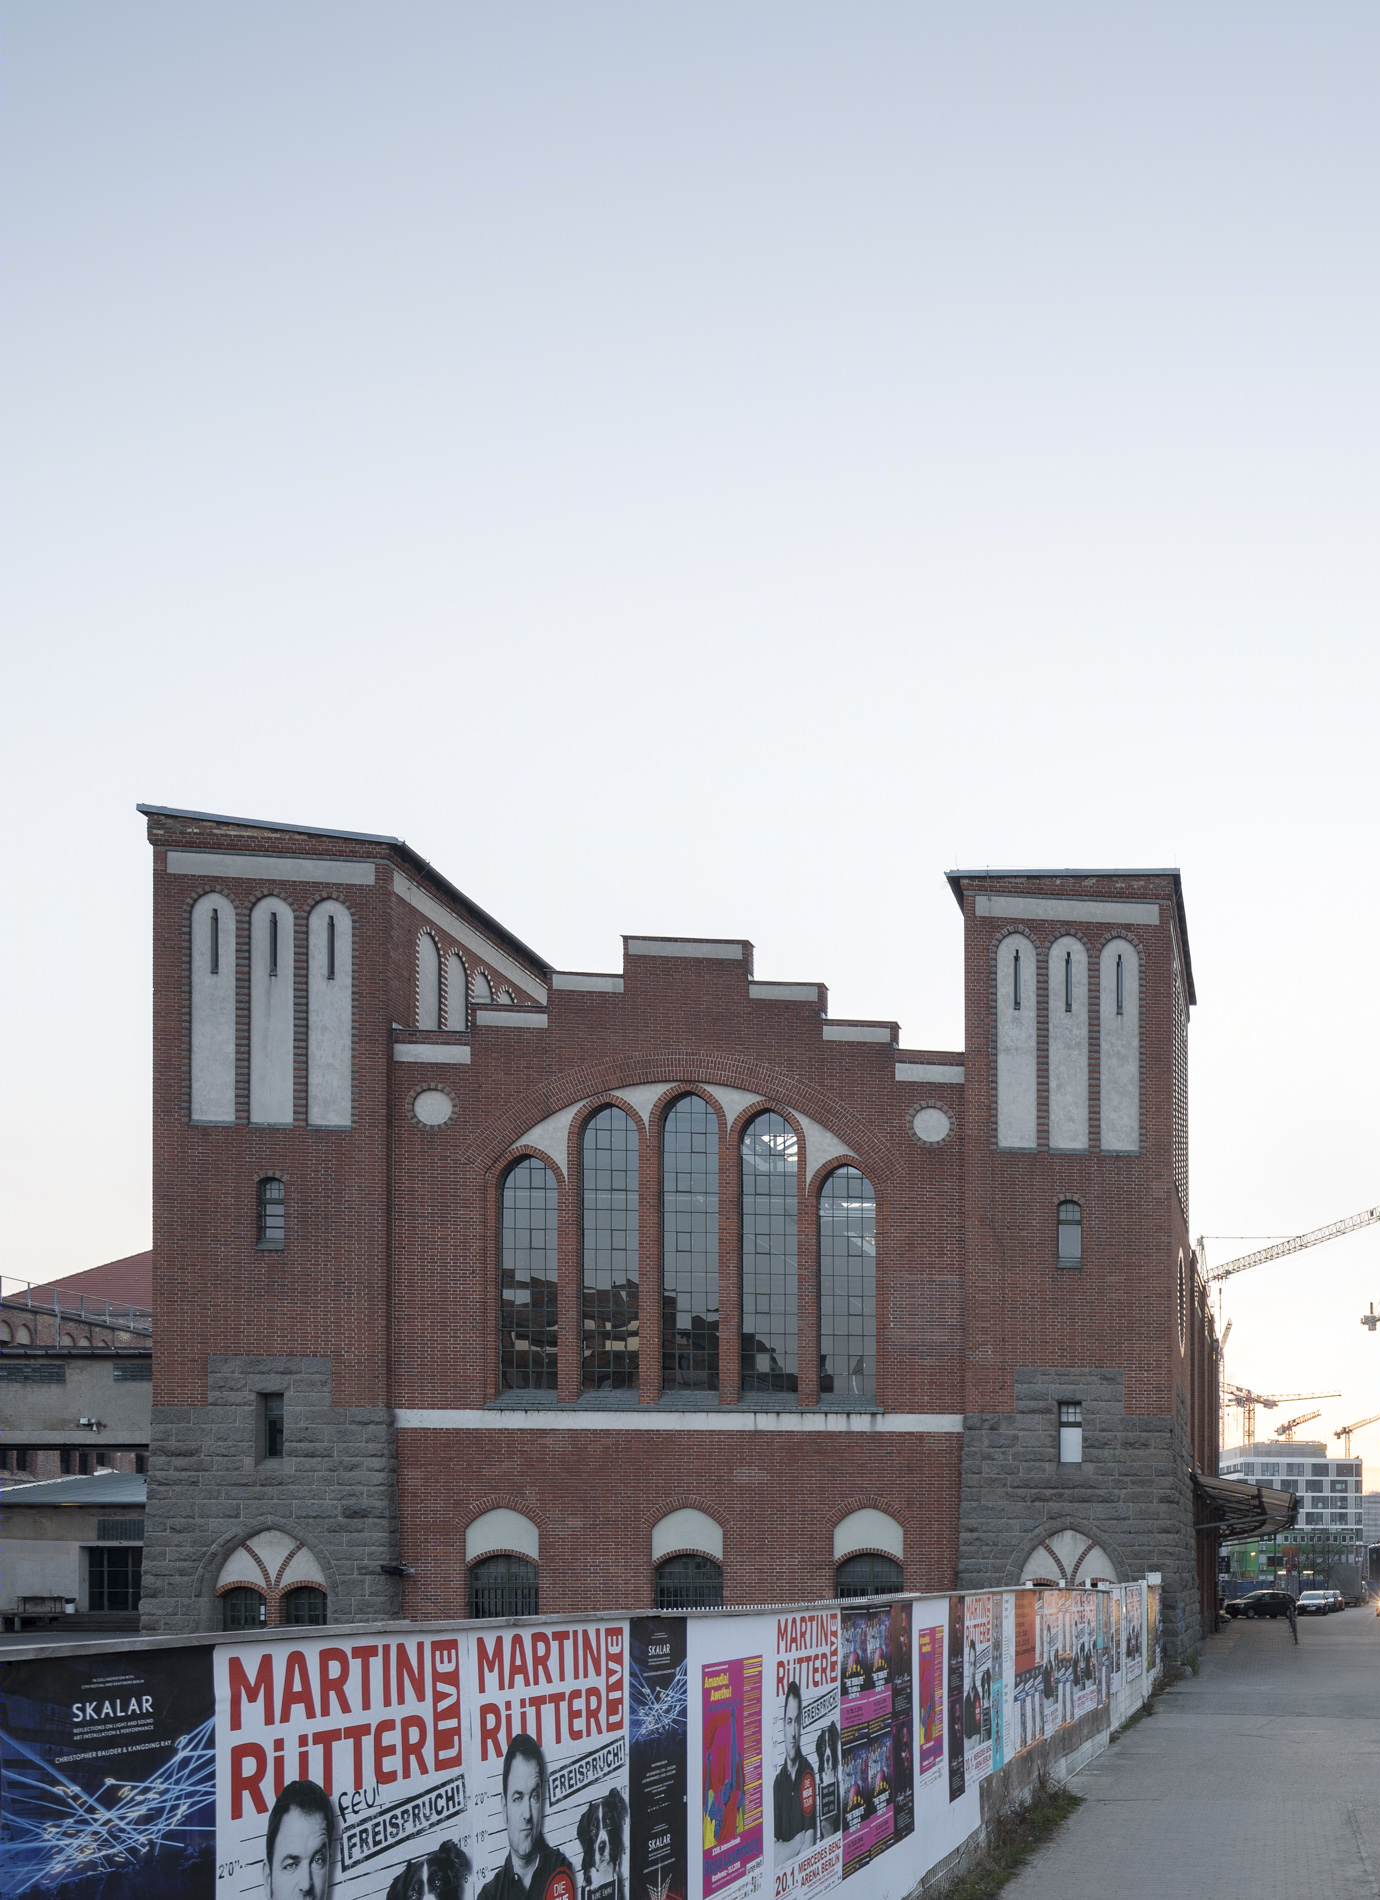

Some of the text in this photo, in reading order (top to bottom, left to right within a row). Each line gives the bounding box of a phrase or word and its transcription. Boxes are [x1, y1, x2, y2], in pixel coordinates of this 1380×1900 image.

[648, 1643, 671, 1656] SKALAR
[776, 1613, 829, 1655] MARTIN
[830, 1618, 838, 1678] LIVE
[476, 1628, 602, 1694] MARTIN
[607, 1634, 624, 1725] LIVE
[229, 1641, 426, 1732] MARTIN
[435, 1648, 460, 1762] LIVE
[72, 1695, 154, 1722] SKALAR
[73, 1724, 105, 1734] REFLECTIONS
[113, 1721, 127, 1729] LIGHT
[137, 1718, 154, 1726] SOUND
[479, 1686, 605, 1762] RÜTTER
[55, 1751, 97, 1764] CHRISTOPHER
[97, 1747, 122, 1758] BAUDER
[128, 1741, 160, 1752] KANGDING
[160, 1739, 172, 1748] RAY
[83, 1730, 116, 1740] INSTALLATION
[120, 1725, 154, 1735] PERFORMANCE
[230, 1714, 430, 1821] RÜTTER
[551, 1743, 624, 1798] FREISPRUCH!
[346, 1784, 462, 1861] FREISPRUCH!
[648, 1834, 671, 1851] SKALAR
[798, 1846, 828, 1875] MERCEDES
[828, 1838, 842, 1856] BENZ
[553, 1881, 566, 1896] DIE
[775, 1866, 798, 1897] 20.1.
[801, 1865, 820, 1888] ARENA
[821, 1852, 840, 1874] BERLIN
